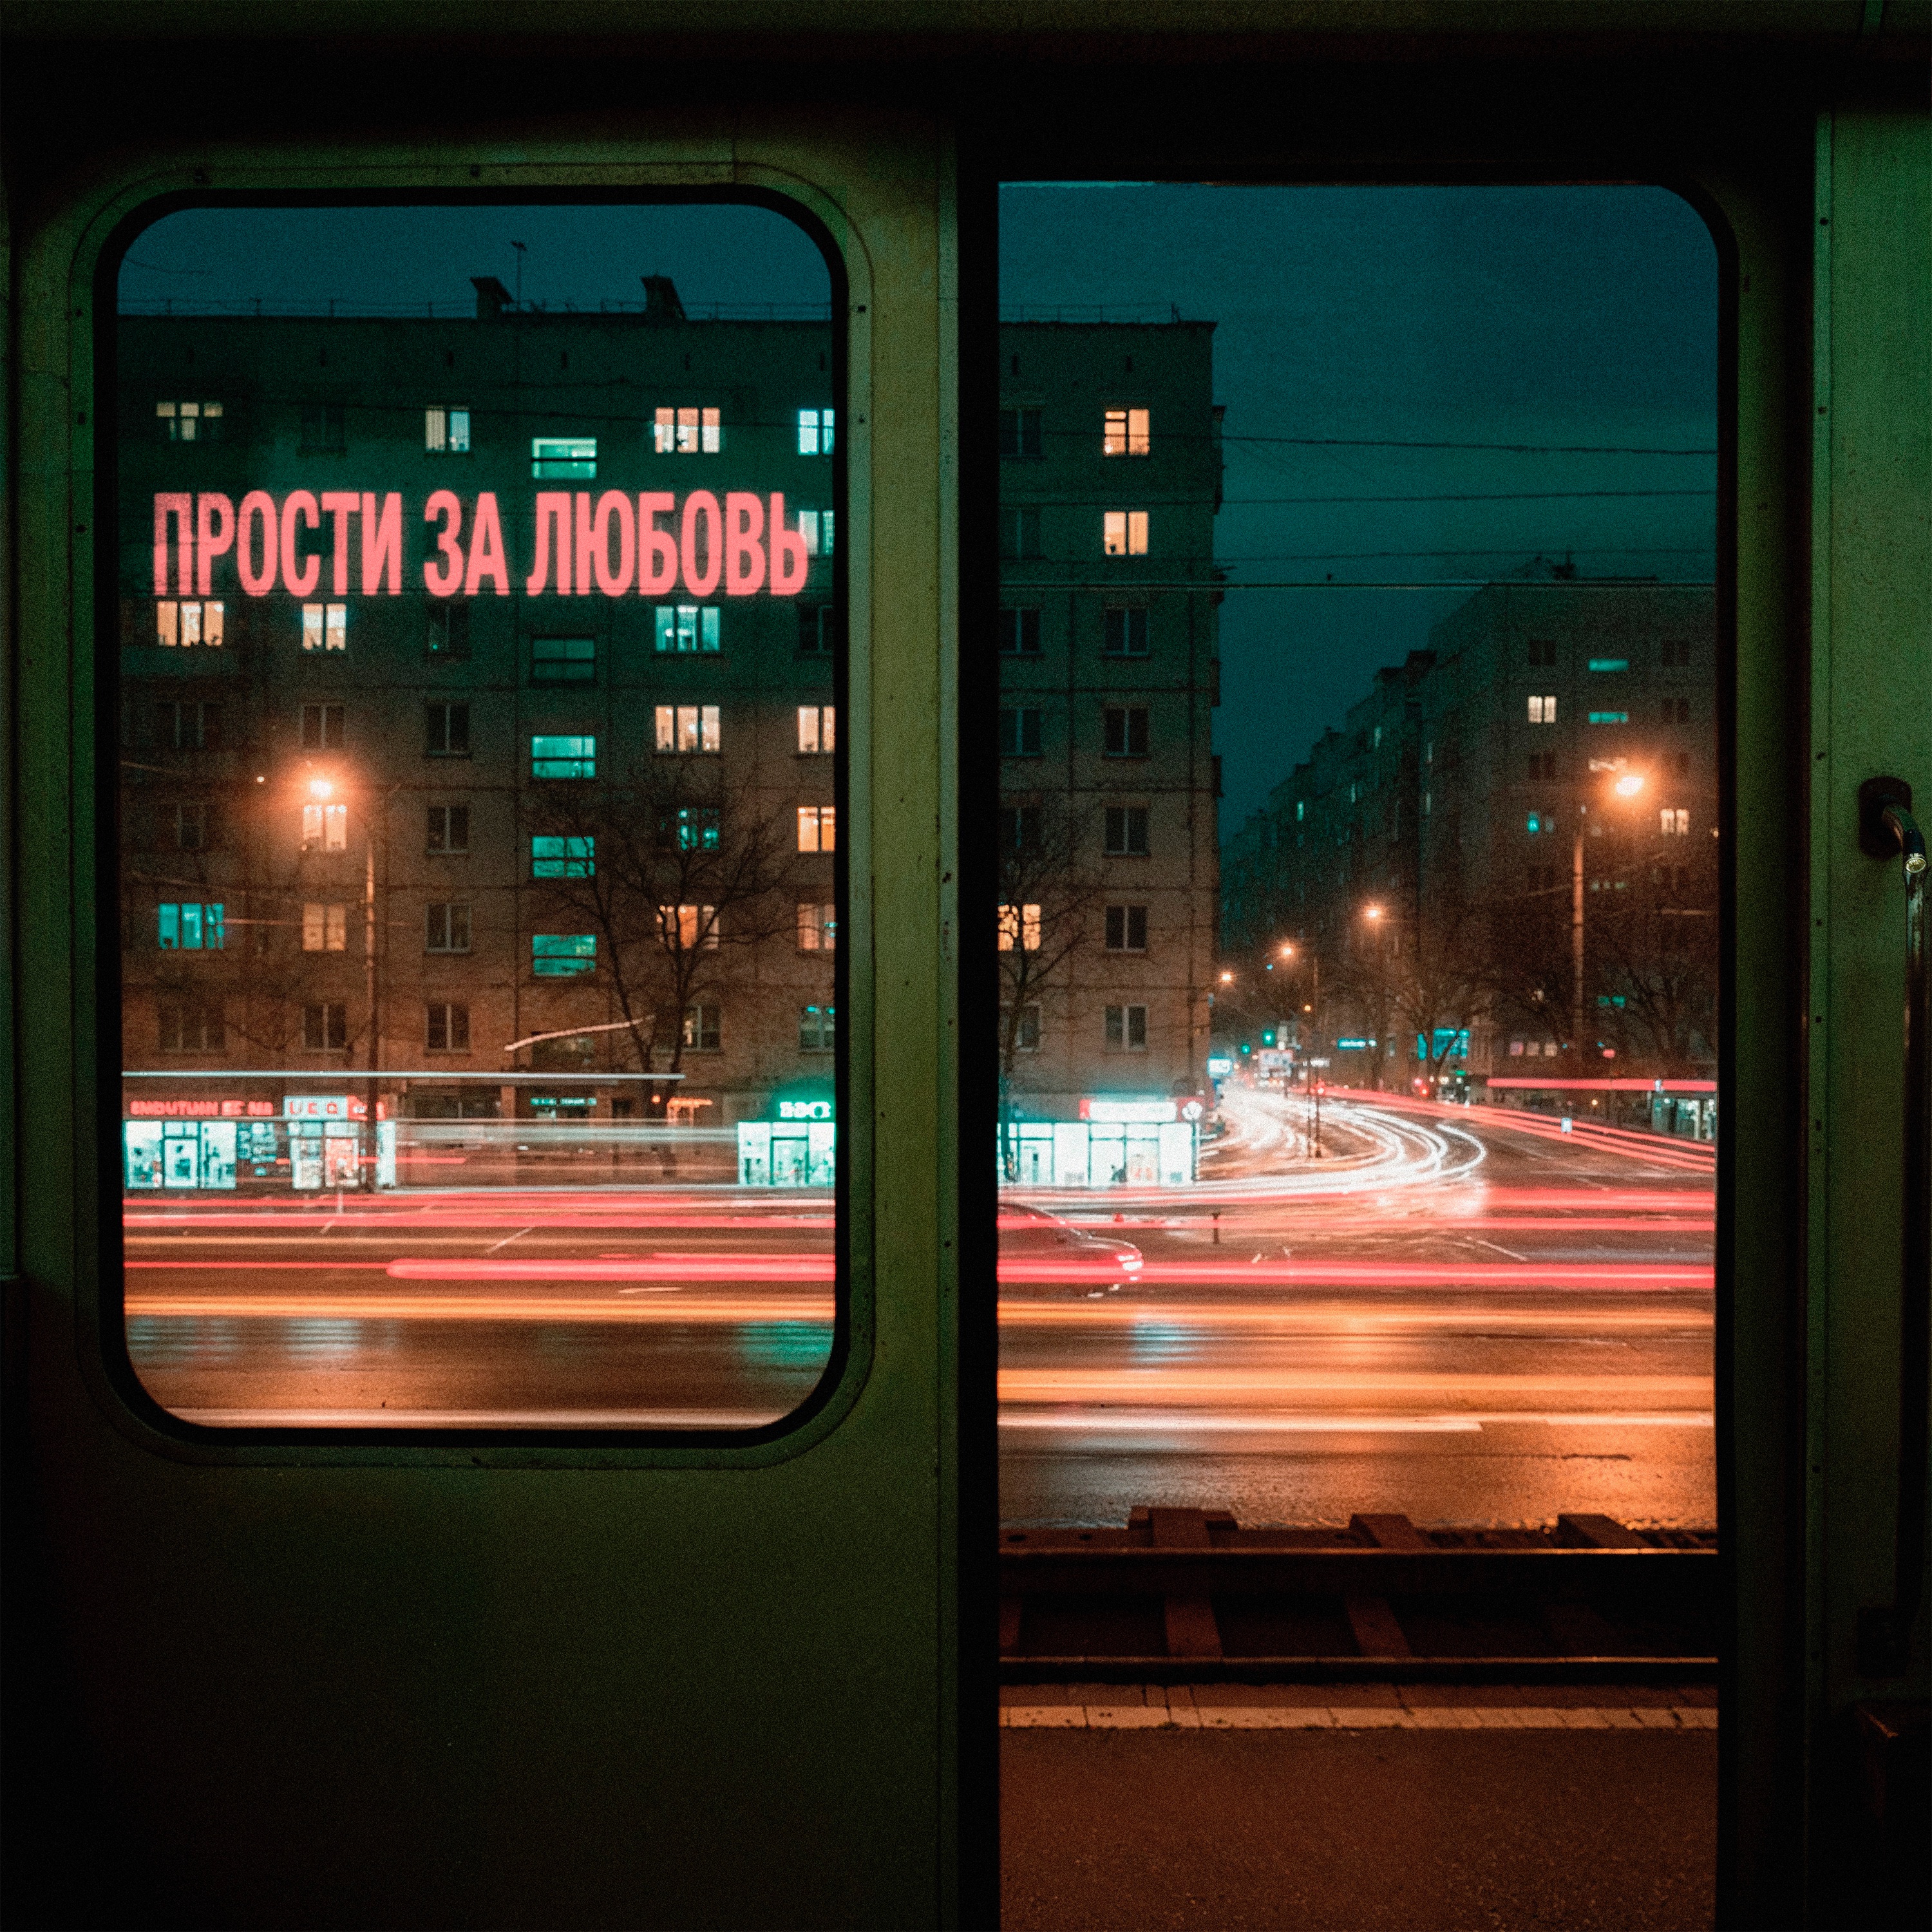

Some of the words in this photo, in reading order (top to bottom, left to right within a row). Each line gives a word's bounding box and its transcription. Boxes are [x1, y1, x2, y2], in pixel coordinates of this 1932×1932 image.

[154, 490, 402, 597] ПРОСТИ
[423, 490, 509, 597] ЗА
[527, 490, 809, 597] ЛЮБОВЬ
